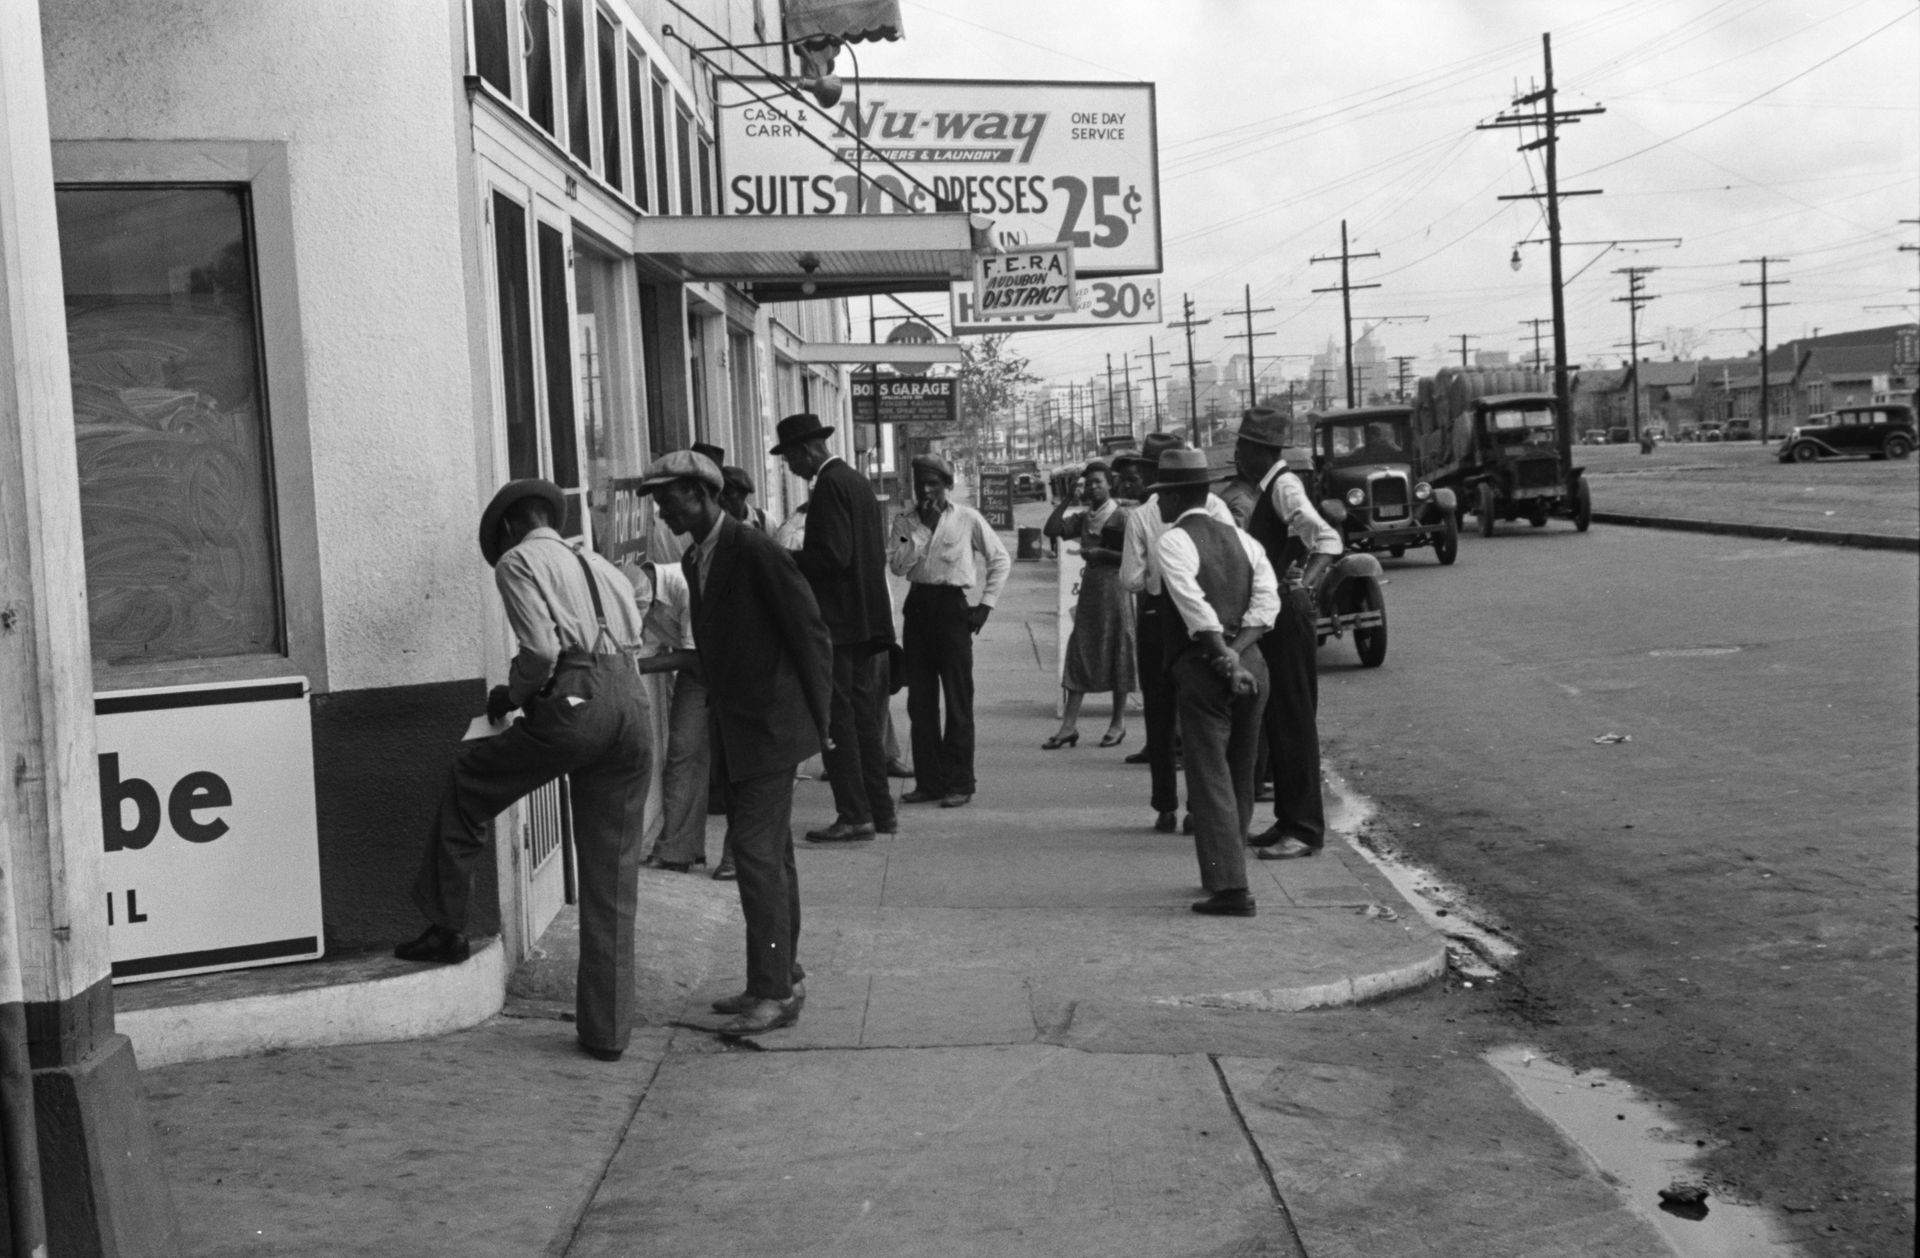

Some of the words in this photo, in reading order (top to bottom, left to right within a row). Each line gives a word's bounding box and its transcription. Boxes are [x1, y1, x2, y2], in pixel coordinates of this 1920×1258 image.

[743, 108, 788, 121] CASH
[798, 109, 808, 121] &
[1071, 112, 1098, 124] ONE
[1102, 113, 1126, 125] DAY
[832, 101, 1047, 163] Nu-way
[1071, 128, 1125, 140] SERVICE
[844, 150, 916, 161] CLEANERS
[920, 150, 930, 161] &
[934, 150, 1001, 161] LAUNDRY
[731, 175, 836, 215] SUITS
[986, 272, 1048, 290] AUDUBON
[982, 285, 1069, 310] DISTRICT
[892, 382, 950, 396] GARAGE
[98, 752, 233, 852] be
